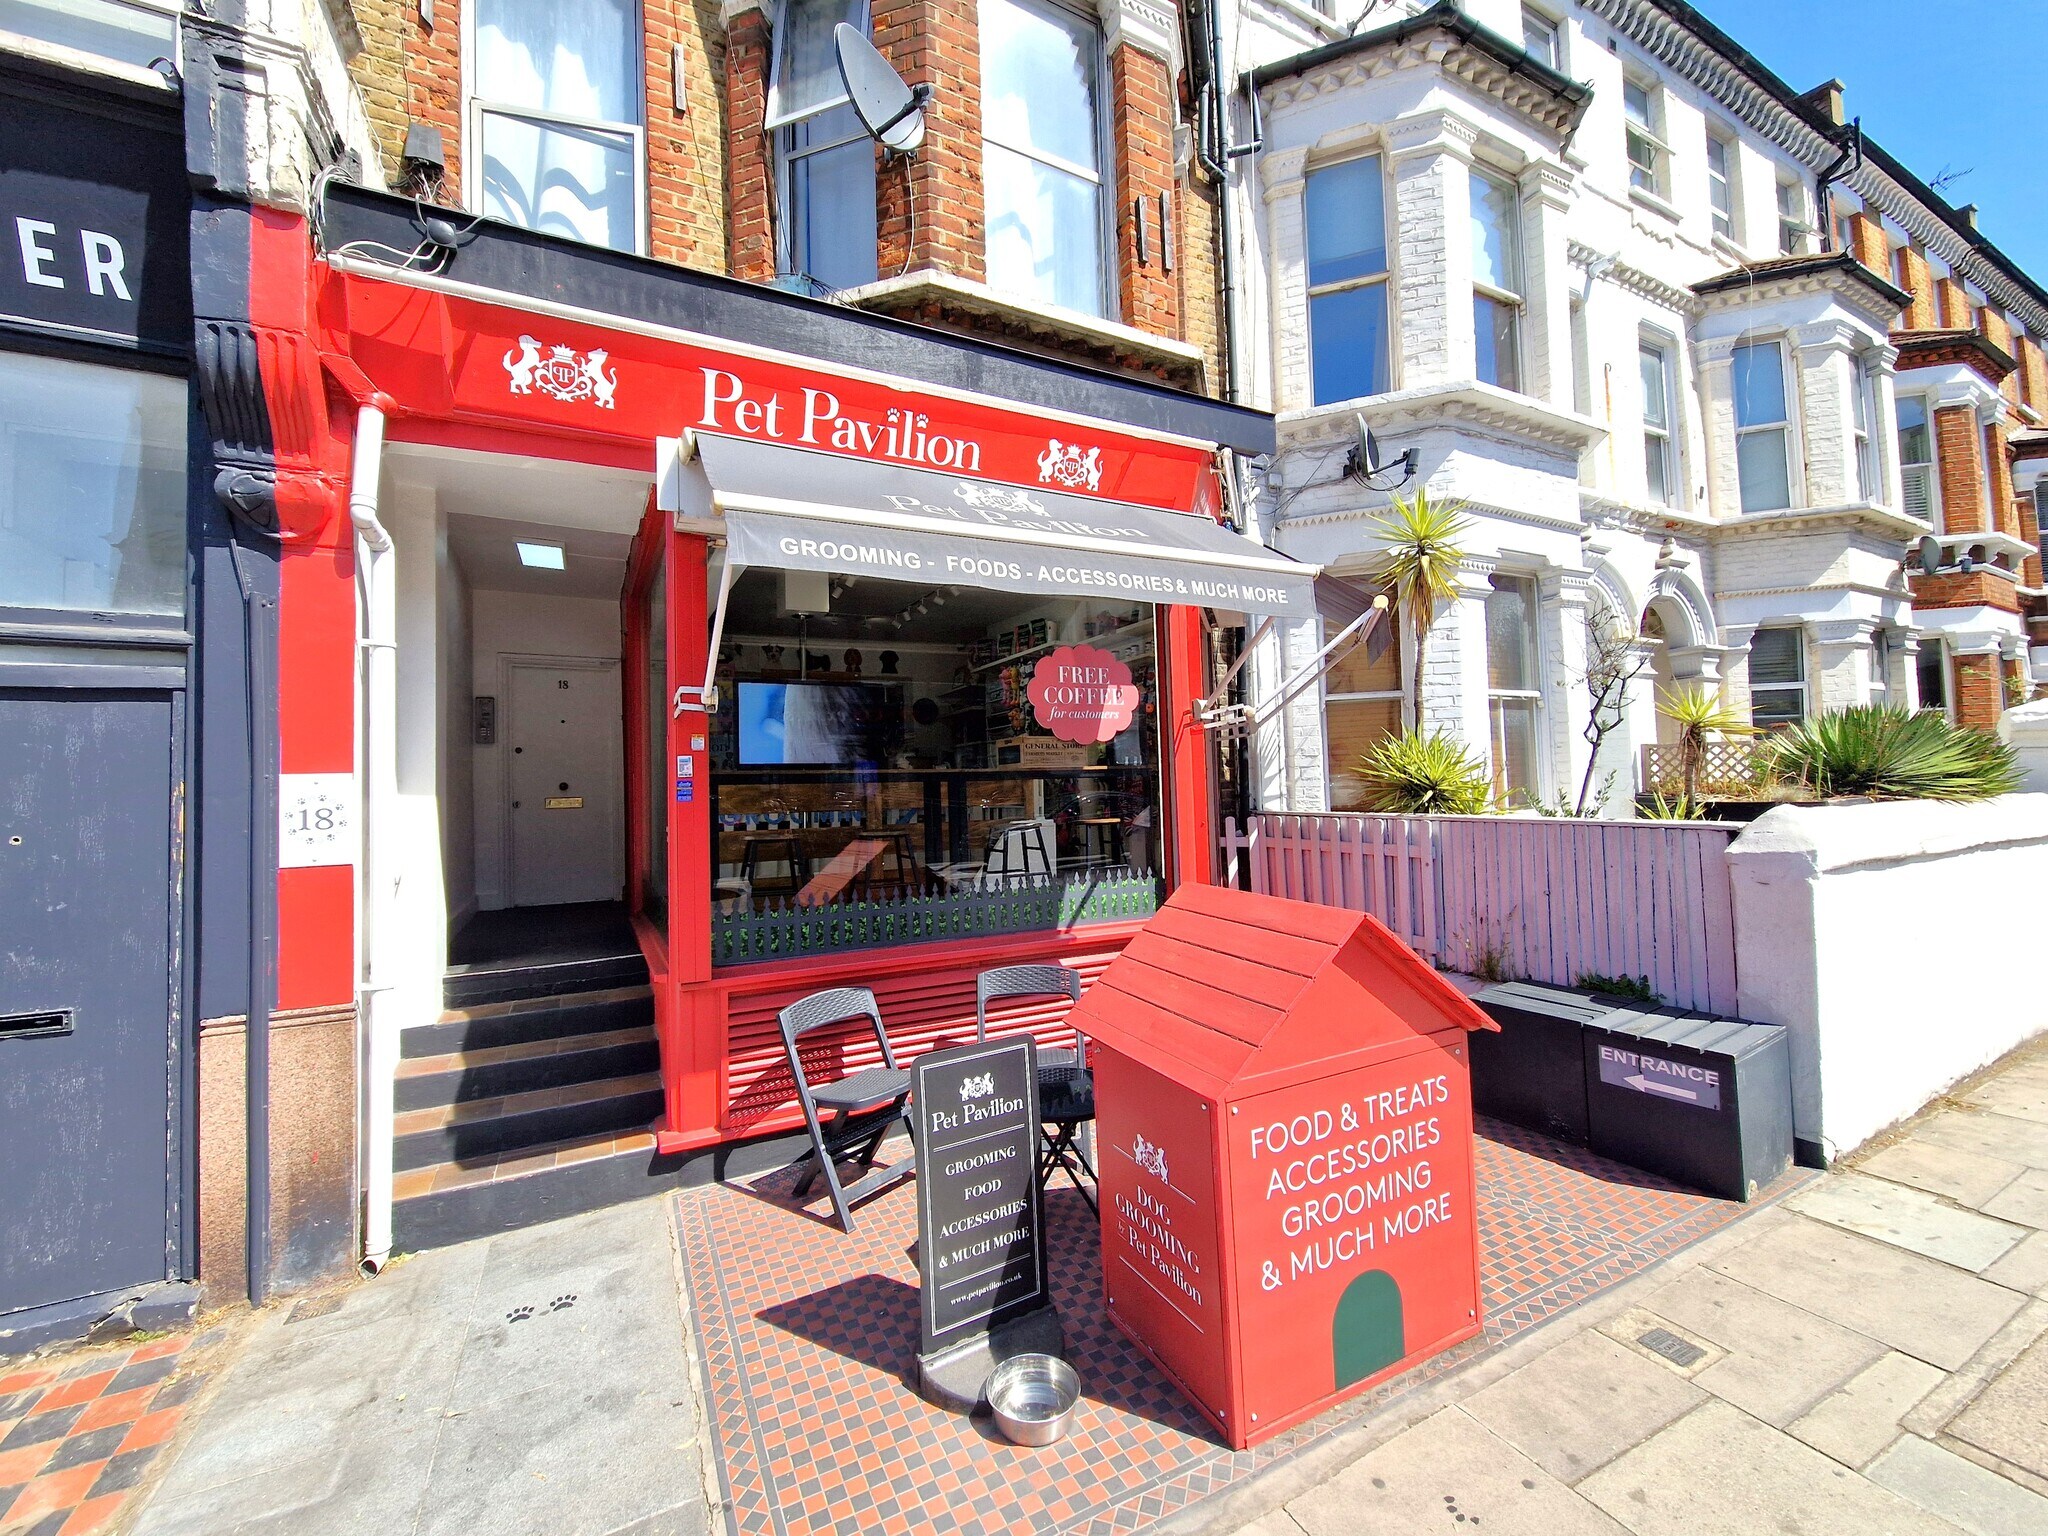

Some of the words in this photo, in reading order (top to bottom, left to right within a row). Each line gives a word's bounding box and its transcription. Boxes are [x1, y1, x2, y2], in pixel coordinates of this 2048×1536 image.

[16, 216, 132, 301] ER
[697, 367, 784, 437] Pet
[798, 387, 981, 471] Pavilion
[881, 494, 969, 520] Pet
[974, 508, 1150, 538] Pavilion
[779, 537, 922, 569] GROOMING
[946, 555, 1022, 580] FOODS
[1037, 565, 1174, 593] ACCESSORIES
[1176, 579, 1188, 594] &
[1191, 580, 1240, 599] MUCH
[1242, 586, 1288, 604] MORE
[558, 680, 569, 689] 18
[1044, 686, 1125, 706] COFFEE
[1058, 666, 1110, 685] FREE
[1047, 706, 1067, 721] for
[1069, 709, 1119, 719] customers
[299, 808, 334, 830] 18
[1601, 1047, 1720, 1085] ENTRANCE
[932, 1111, 958, 1132] Pet
[963, 1098, 1024, 1124] Pavilion
[1250, 1111, 1333, 1159] FOOD
[1340, 1103, 1359, 1133] &
[1363, 1075, 1449, 1124] TREATS
[945, 1145, 1016, 1176] GROOMING
[1266, 1117, 1441, 1200] ACCESSORIES
[964, 1179, 1002, 1200] FOOD
[1137, 1185, 1171, 1225] DOG
[1281, 1160, 1432, 1238] GROOMING
[939, 1199, 1028, 1239] ACCESSORIES
[1115, 1192, 1200, 1274] GROOMING
[939, 1256, 949, 1268] &
[951, 1239, 991, 1264] MUCH
[993, 1226, 1030, 1249] MORE
[1261, 1260, 1283, 1292] &
[1290, 1226, 1374, 1280] MUCH
[1383, 1192, 1452, 1244] MORE
[1127, 1225, 1148, 1259] Pet
[1150, 1243, 1202, 1306] Pavilion
